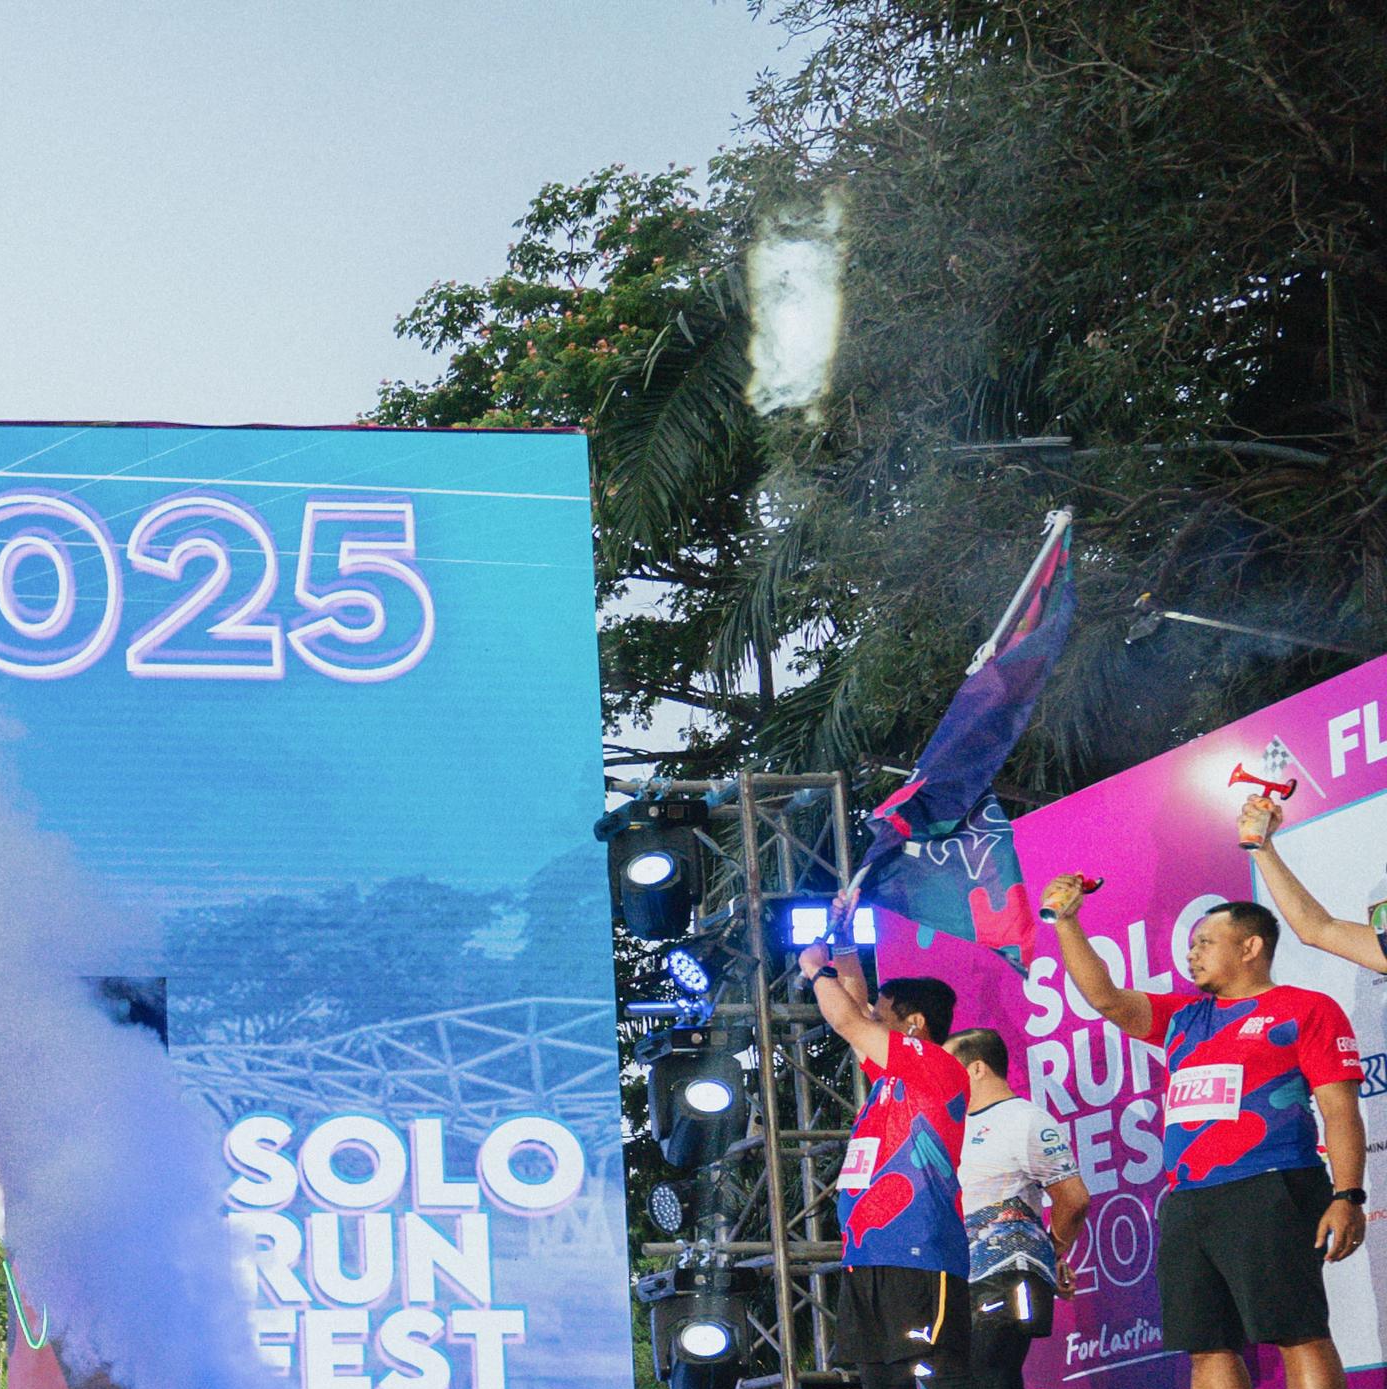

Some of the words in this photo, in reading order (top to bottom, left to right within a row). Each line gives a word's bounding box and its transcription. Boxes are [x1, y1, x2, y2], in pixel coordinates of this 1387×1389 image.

[1174, 1079, 1214, 1102] 7724
[227, 1115, 586, 1209] SOLO
[227, 1212, 492, 1304] RUN
